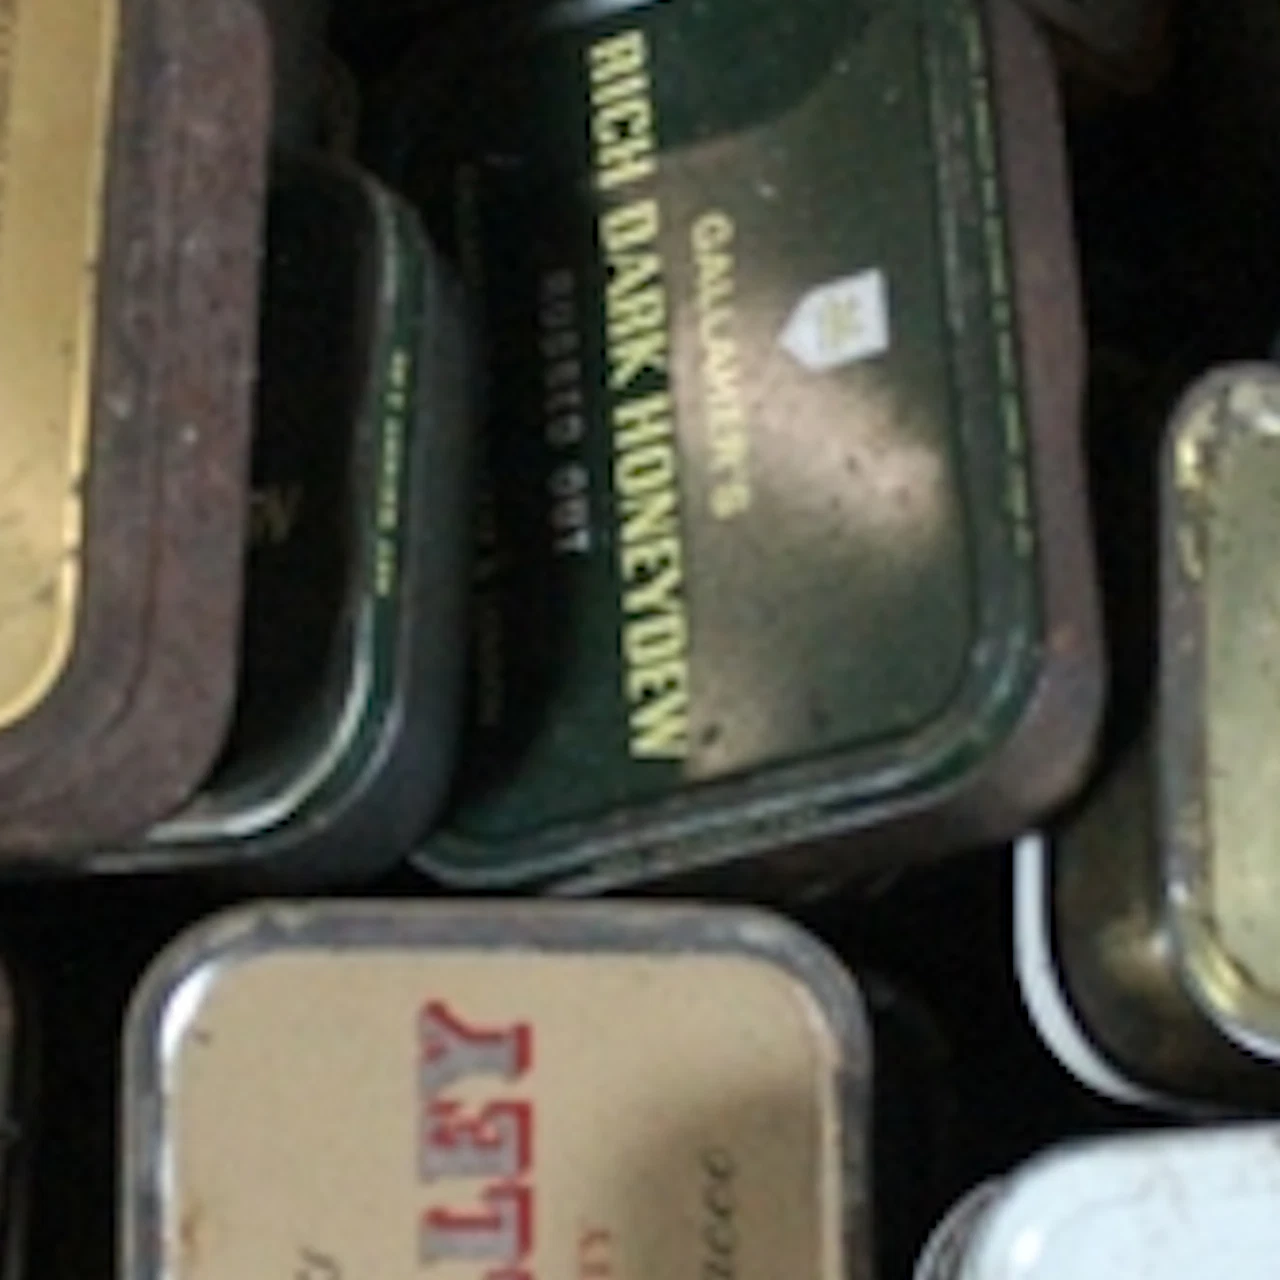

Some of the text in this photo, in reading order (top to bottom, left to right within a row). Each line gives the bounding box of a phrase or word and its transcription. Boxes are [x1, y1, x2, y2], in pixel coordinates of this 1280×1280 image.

[587, 29, 691, 762] RICH DARK HONEYDEW
[691, 210, 757, 520] GALLAHER'S
